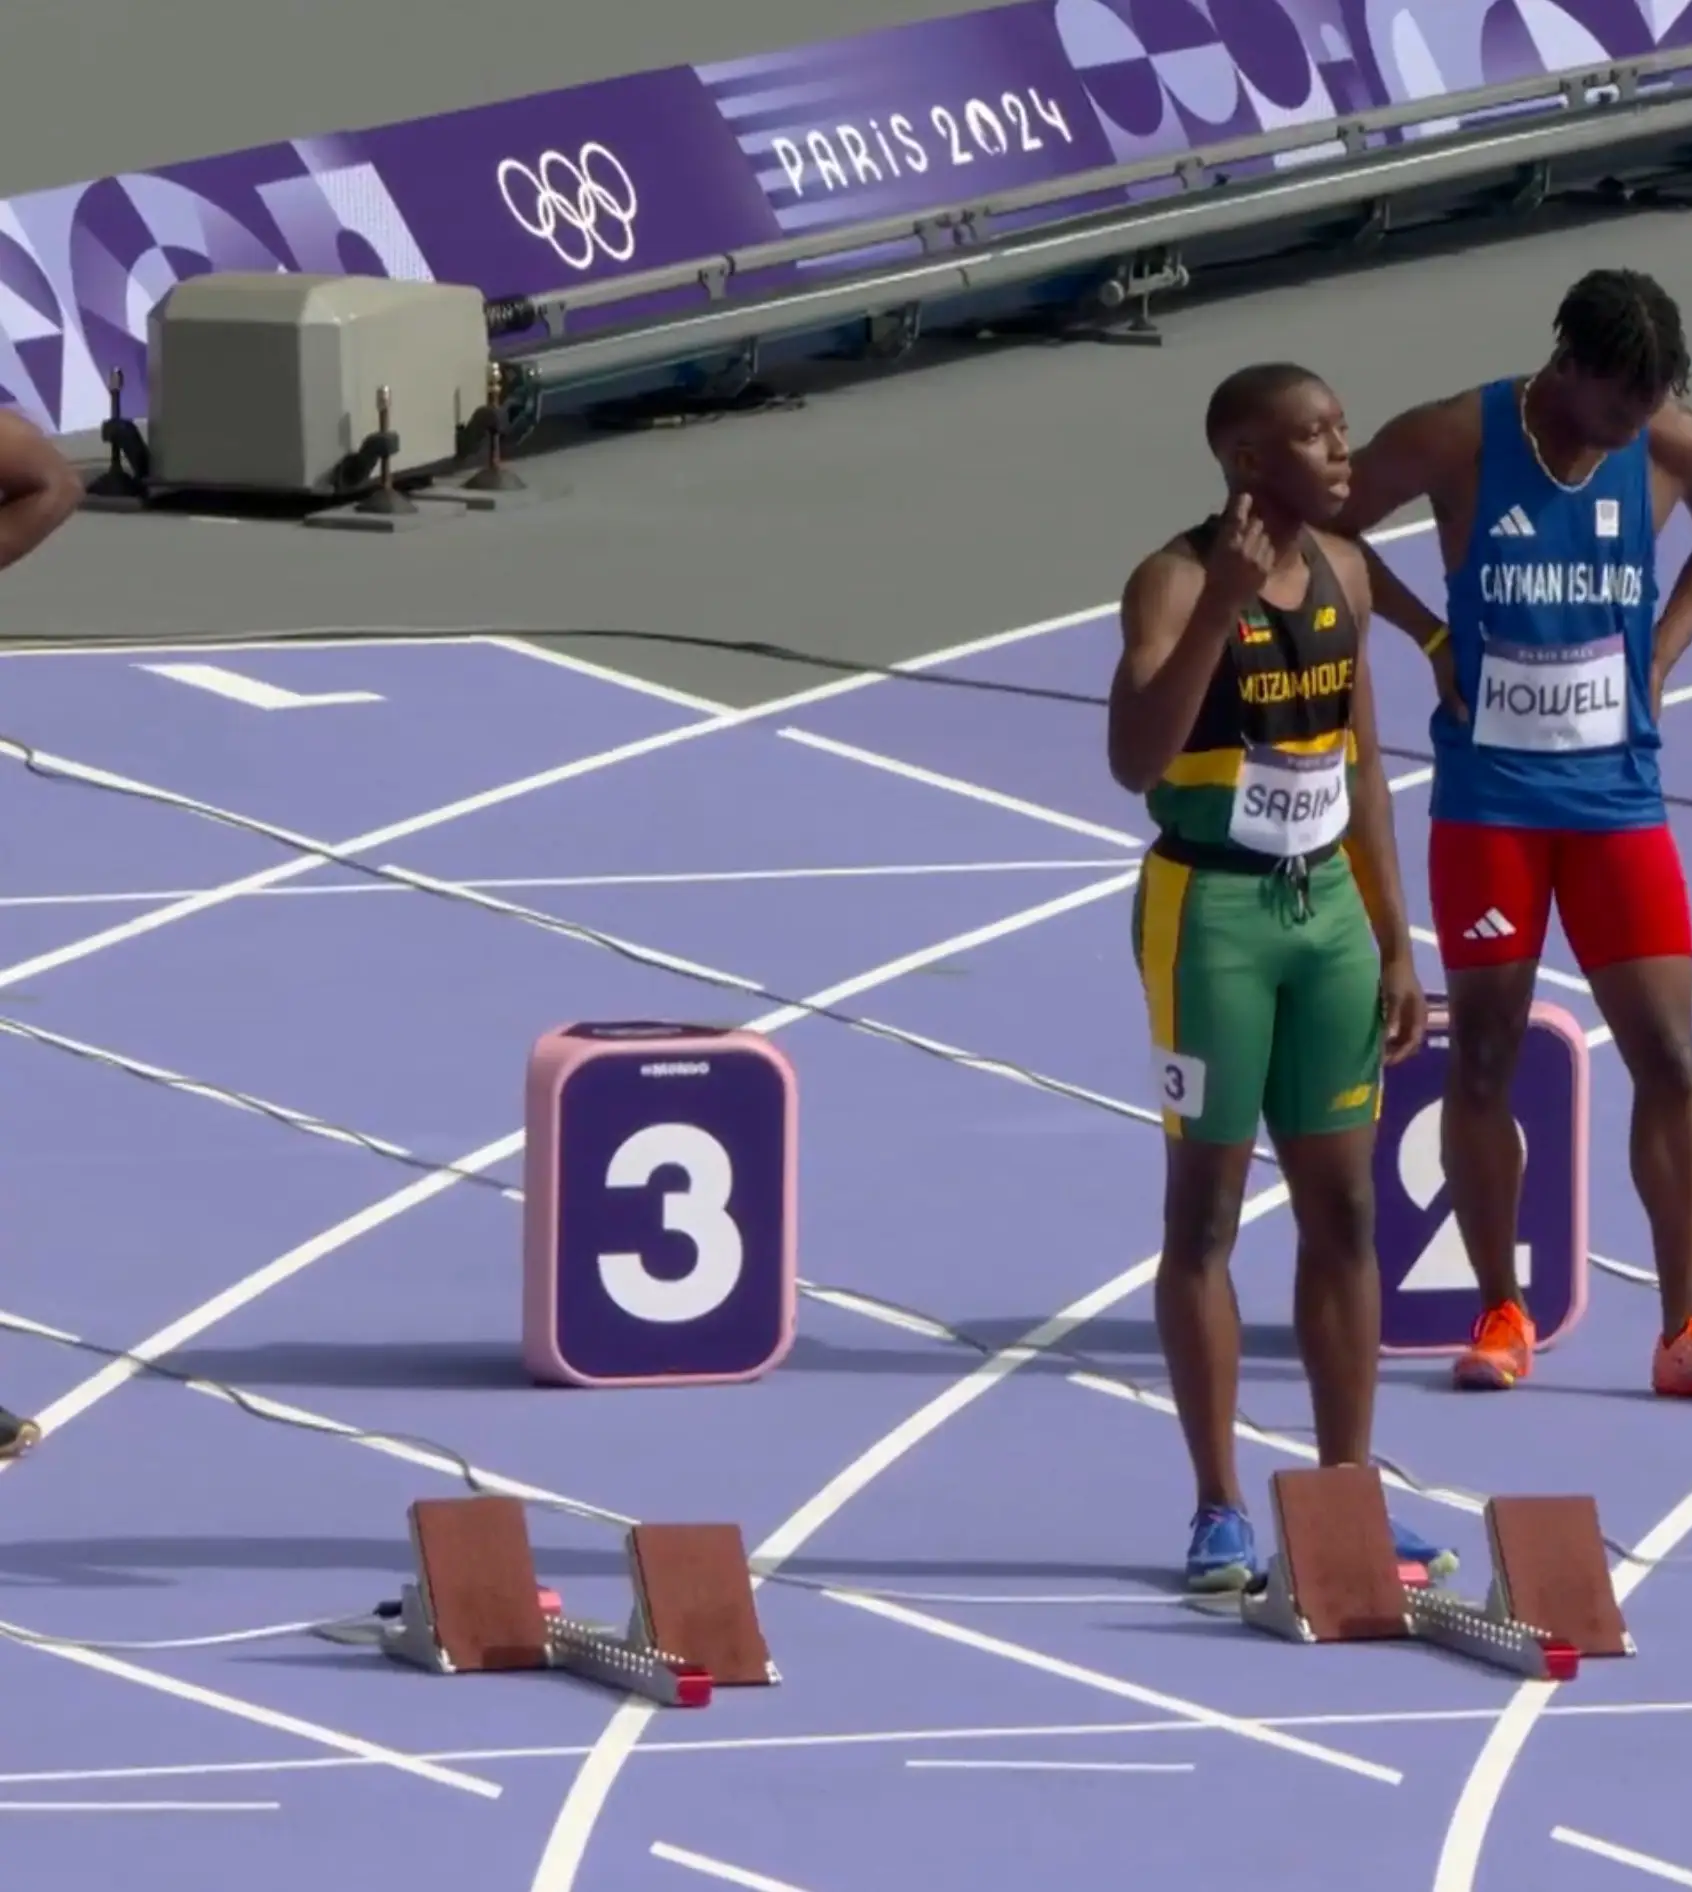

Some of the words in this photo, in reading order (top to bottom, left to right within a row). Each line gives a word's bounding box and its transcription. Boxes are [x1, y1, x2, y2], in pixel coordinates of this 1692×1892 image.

[931, 86, 1073, 167] 2024
[1480, 561, 1563, 604] CAYMAN
[1567, 562, 1643, 606] ISLANDS
[1485, 676, 1620, 717] HOWELL
[1163, 1065, 1185, 1101] 3
[597, 1122, 744, 1323] 3
